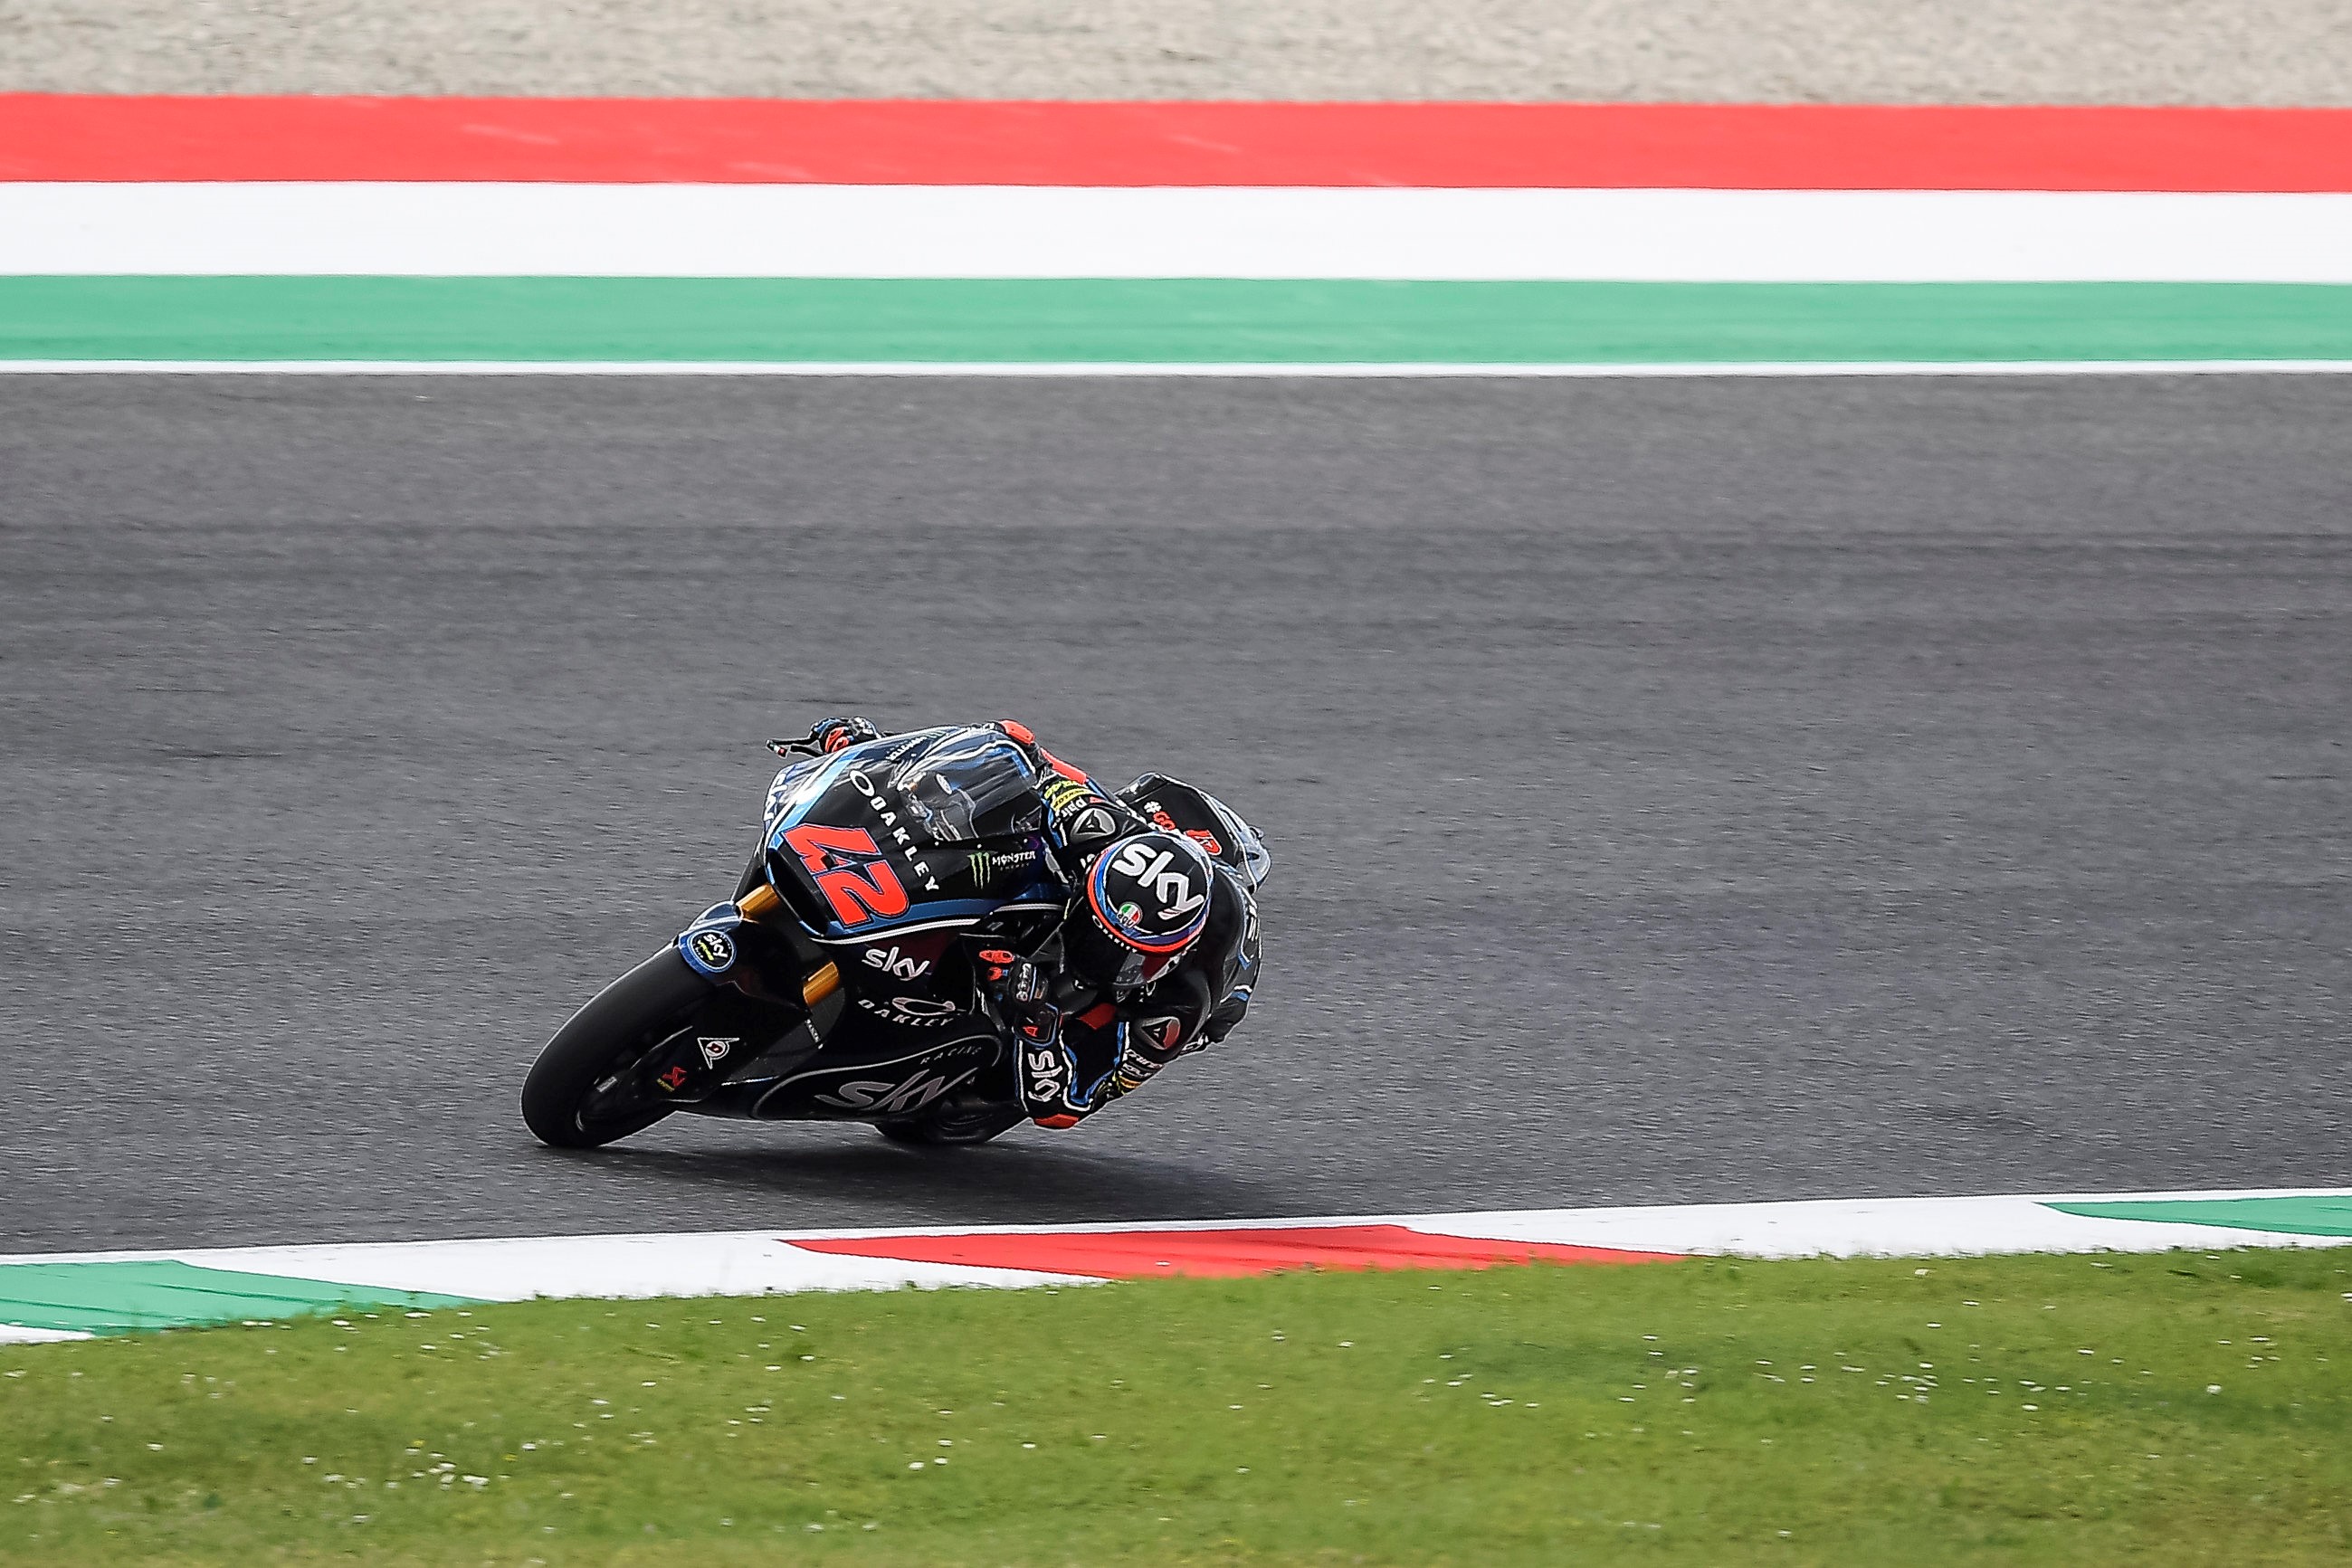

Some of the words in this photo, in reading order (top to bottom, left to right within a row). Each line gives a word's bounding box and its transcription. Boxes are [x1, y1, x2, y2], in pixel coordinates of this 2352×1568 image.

[870, 794, 940, 892] OAKLEY
[991, 851, 1036, 866] MONSTER
[782, 822, 909, 927] 42
[1111, 842, 1205, 920] sky
[702, 933, 729, 958] sky
[862, 946, 930, 982] sky
[857, 998, 954, 1027] OAKLEY
[1027, 1050, 1063, 1103] sky
